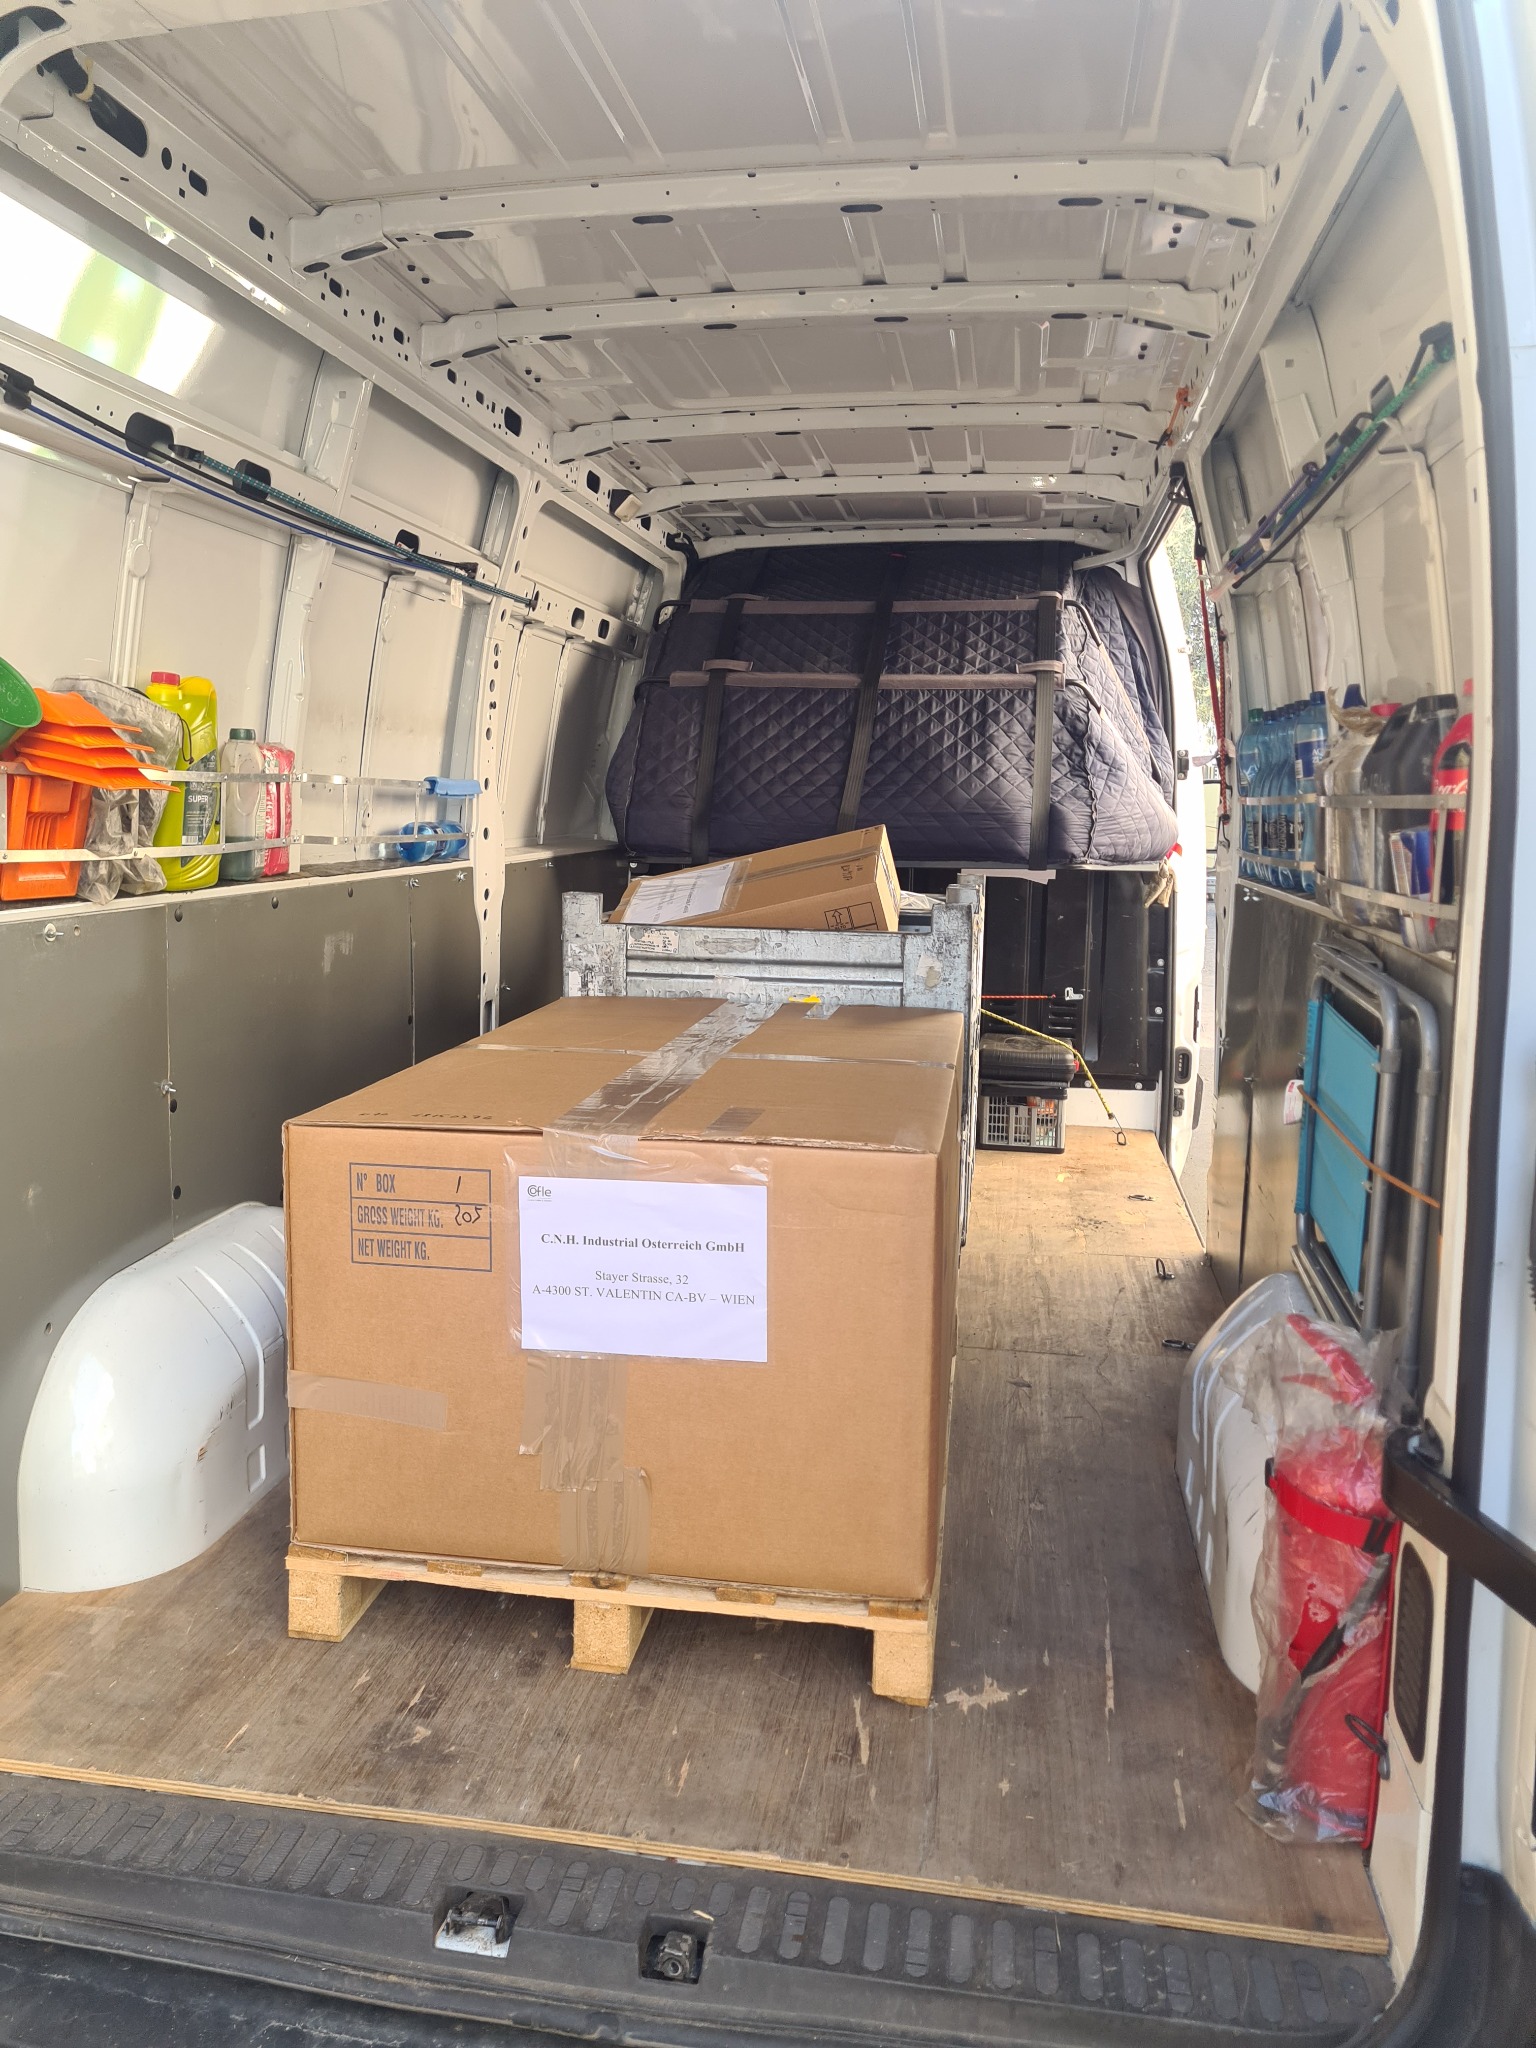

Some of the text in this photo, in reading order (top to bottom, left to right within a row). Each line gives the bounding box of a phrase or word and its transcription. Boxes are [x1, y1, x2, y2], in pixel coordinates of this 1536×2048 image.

[187, 795, 209, 803] SUPER
[376, 1173, 396, 1193] BOX
[357, 1204, 444, 1229] GROSS WEIGHT KG.
[455, 1204, 483, 1226] 205
[358, 1237, 430, 1261] NET WEIGHT KG.
[541, 1233, 745, 1253] C.N.H. Industrial Osterreich GmbH
[595, 1270, 689, 1285] Stayer Strasse, 32
[532, 1284, 571, 1296] A-4300
[574, 1286, 593, 1297] ST.
[596, 1287, 662, 1301] VALENTIN
[665, 1291, 707, 1303] CA-BV
[720, 1293, 756, 1305] WIEN
